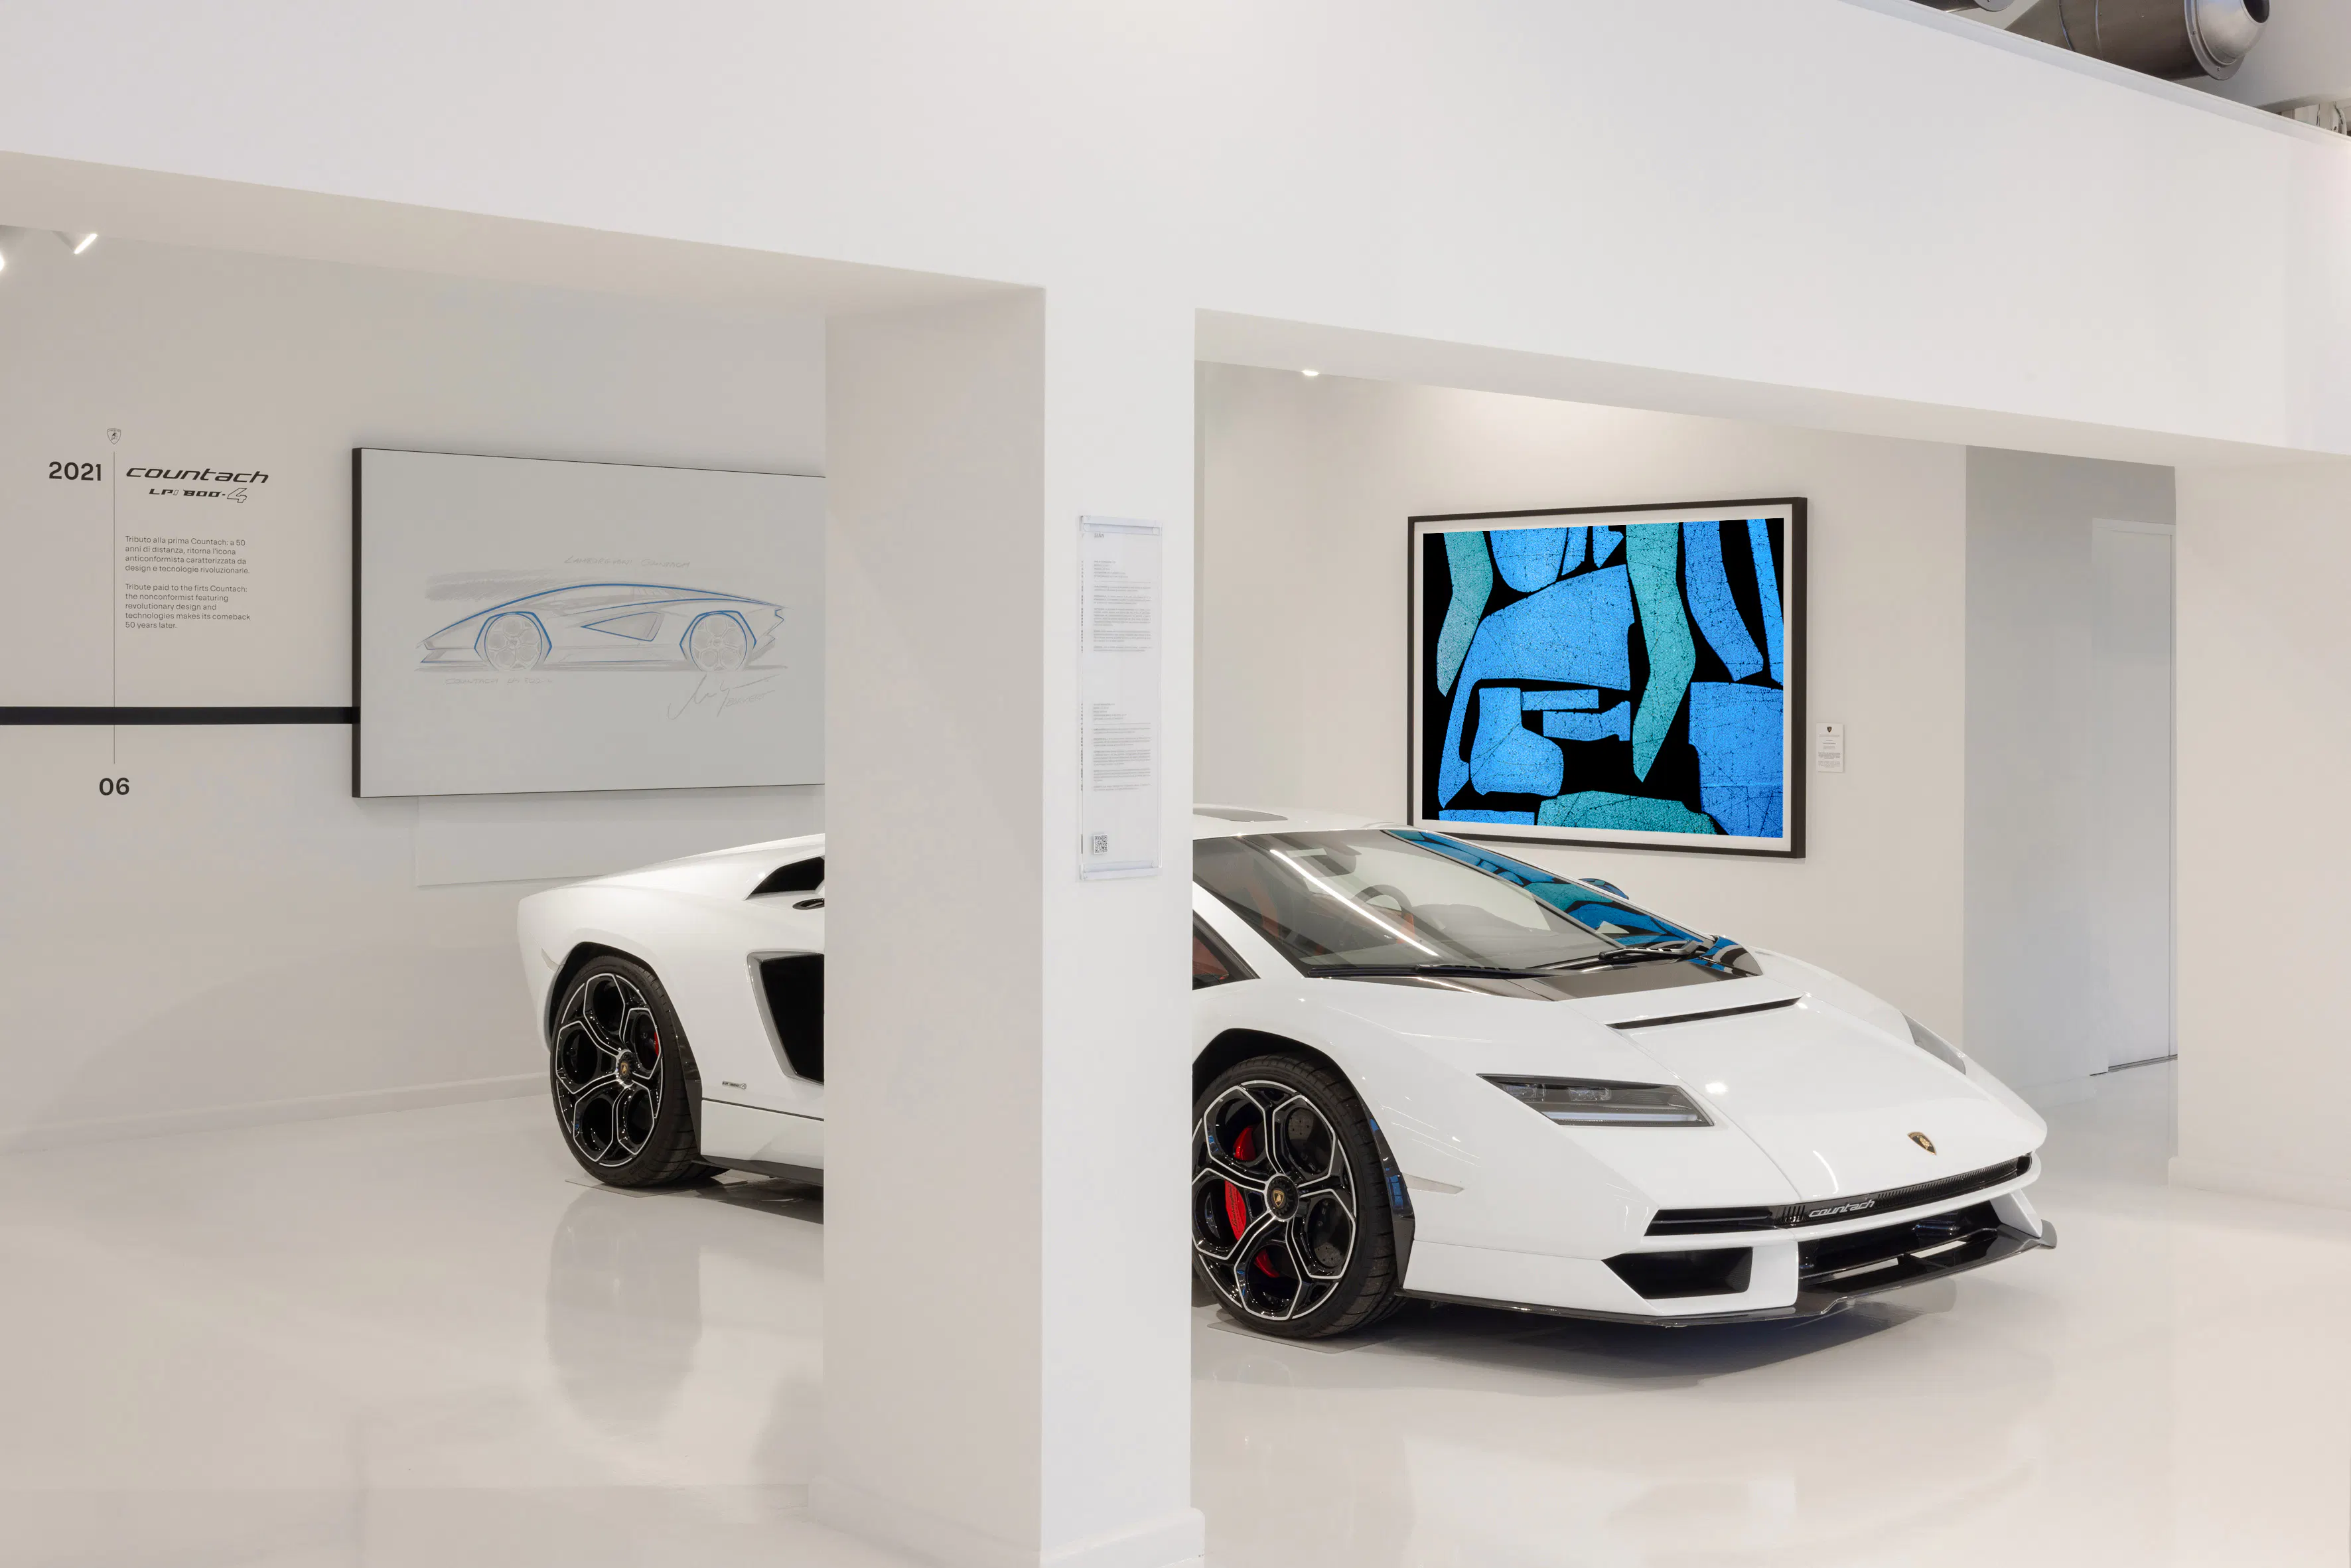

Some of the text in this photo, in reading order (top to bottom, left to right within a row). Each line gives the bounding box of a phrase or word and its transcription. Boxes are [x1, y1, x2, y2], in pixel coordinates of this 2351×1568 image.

[49, 461, 102, 481] 2021
[126, 467, 269, 484] countach
[196, 594, 228, 603] featuring
[100, 777, 129, 796] 06
[1809, 1200, 1875, 1218] countach
